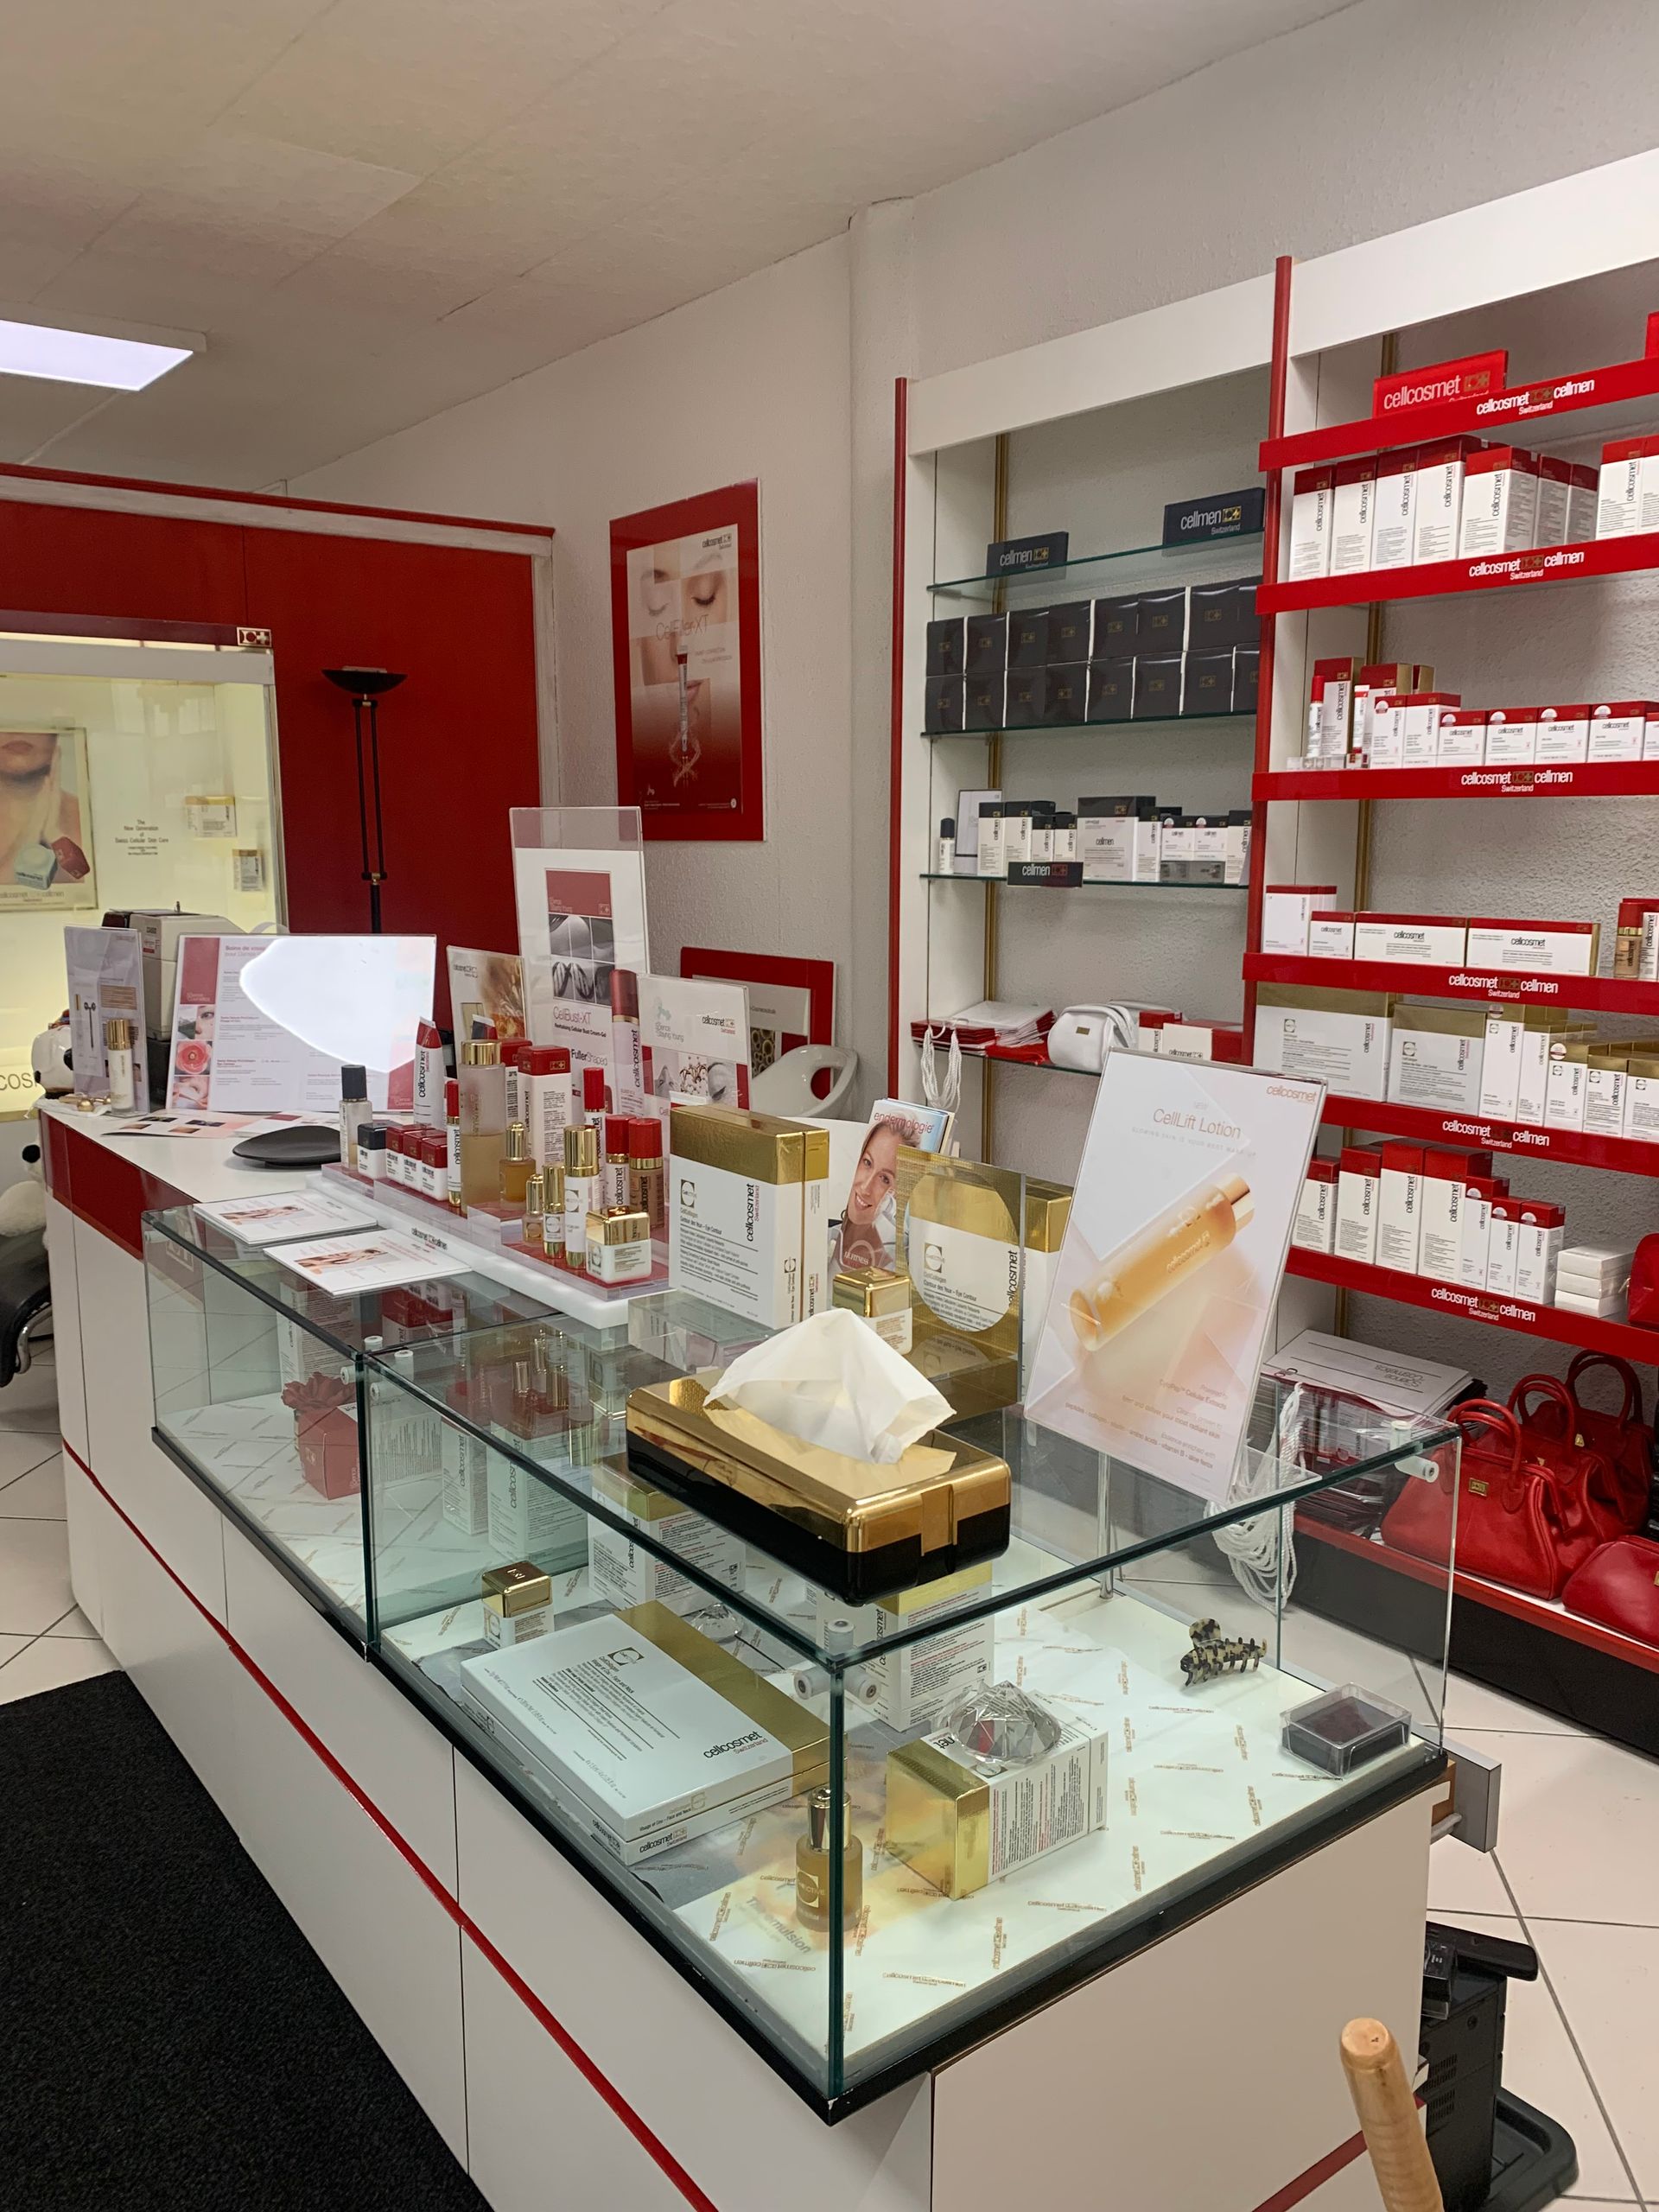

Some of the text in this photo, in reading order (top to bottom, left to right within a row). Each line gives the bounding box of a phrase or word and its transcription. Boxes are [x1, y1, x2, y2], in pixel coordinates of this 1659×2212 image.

[1383, 375, 1460, 410] cellcosmet
[1476, 391, 1529, 416] cellcosmet
[1554, 379, 1595, 399] cellmen
[1518, 401, 1553, 416] Switzerland
[1402, 474, 1410, 516] cellcosmet
[1444, 465, 1453, 507] cellcosmet
[1492, 473, 1503, 517] cellcosmet
[1626, 461, 1637, 502] cellcosmet
[1315, 492, 1324, 531] cellcosmet
[1360, 483, 1369, 524] cellcosmet
[1180, 509, 1222, 531] cellmen
[1211, 524, 1241, 535] Switzerland
[1000, 549, 1033, 568] cellmen
[1469, 550, 1585, 577] cellcosmet cellmen
[1510, 569, 1543, 581] Switzerland
[1461, 769, 1573, 785] cellcosmet cellmen
[1096, 836, 1115, 846] cellmen
[1022, 863, 1051, 877] cellmen
[1394, 931, 1425, 940] cellcosmet
[1511, 937, 1546, 948] cellcosmet
[1646, 914, 1656, 947] cellcosmet
[1448, 974, 1559, 994] cellcosmet cellmen
[1488, 989, 1520, 999] Switzerland
[702, 1015, 725, 1027] cellcosmet
[631, 1030, 640, 1088] cellcosmet
[1458, 1039, 1466, 1071] cellcosmet
[1266, 1084, 1317, 1103] cellcosmet
[1612, 1073, 1621, 1106] cellcosmet
[1153, 1108, 1241, 1140] CellLift Lotion
[1442, 1120, 1550, 1147] cellcosmet cellmen
[1481, 1137, 1512, 1149] Switzerland
[1319, 1184, 1328, 1220] cellcosmet
[1363, 1179, 1373, 1216] cellcosmet
[1406, 1175, 1415, 1213] cellcosmet
[1450, 1184, 1459, 1223] cellcosmet
[746, 1184, 754, 1242] cellcosmet
[1431, 1287, 1536, 1322] cellcosmet cellmen
[1469, 1307, 1499, 1321] Switzerland
[460, 1434, 468, 1487] cellcosmet
[628, 1516, 639, 1568] cellcoset
[703, 1731, 763, 1758] cellcosmet
[734, 1737, 768, 1755] Switzerland
[639, 1833, 673, 1853] cellcosmet
